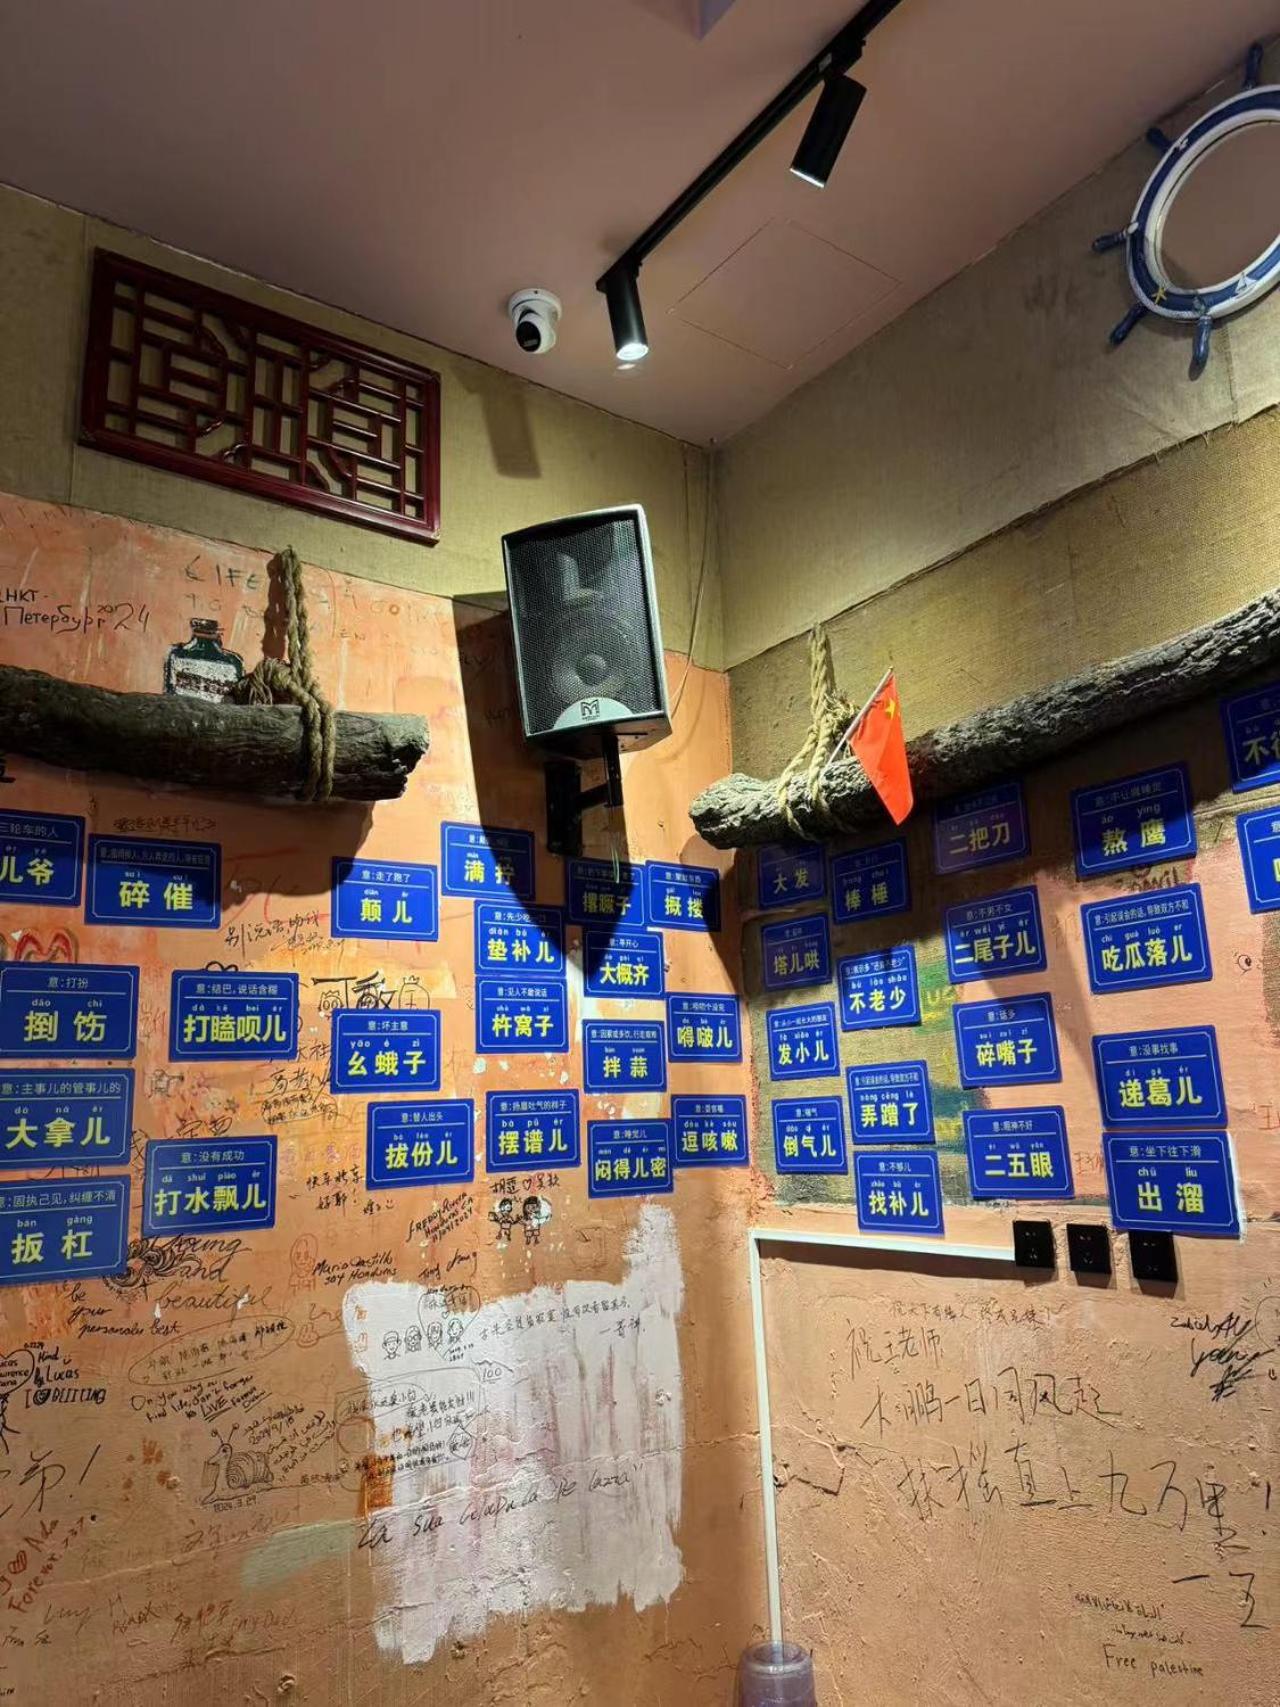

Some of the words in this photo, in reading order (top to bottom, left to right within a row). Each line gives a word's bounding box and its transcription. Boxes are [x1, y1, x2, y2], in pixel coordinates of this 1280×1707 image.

[949, 821, 1012, 854] 二把刀
[119, 880, 195, 911] 碎催
[361, 897, 413, 924] 颠儿
[488, 938, 555, 963] 垫补儿
[955, 930, 1037, 964] 二尾子儿
[1101, 934, 1193, 973] 吃瓜落儿
[48, 977, 89, 989] 意：打扮
[600, 961, 650, 987] 大概齐
[849, 986, 907, 1014] 不老少
[24, 1010, 108, 1043] 捯饬
[183, 1013, 287, 1044] 打瞌呗儿
[492, 1013, 554, 1038] 杵窝子
[778, 1039, 830, 1066] 发小儿
[975, 1038, 1038, 1069] 碎嘴子
[603, 1055, 649, 1079] 拌蒜
[1118, 1076, 1203, 1109] 递葛儿
[860, 1102, 919, 1129] 弄蹭了
[5, 1116, 112, 1151] 大拿儿
[498, 1127, 568, 1156] 摆谱儿
[681, 1130, 739, 1153] 逗咳嗽
[181, 1150, 245, 1164] 意：没有成功
[385, 1139, 459, 1170] 拔份儿
[984, 1151, 1055, 1179] 二五眼
[595, 1156, 667, 1182] 闷得儿密
[154, 1182, 268, 1217] 打水飘儿
[868, 1190, 930, 1217] 找补儿
[1137, 1181, 1205, 1214] 出溜
[11, 1228, 94, 1265] 扳杠
[46, 1364, 80, 1382] Lucas
[1103, 1643, 1137, 1670] Free
